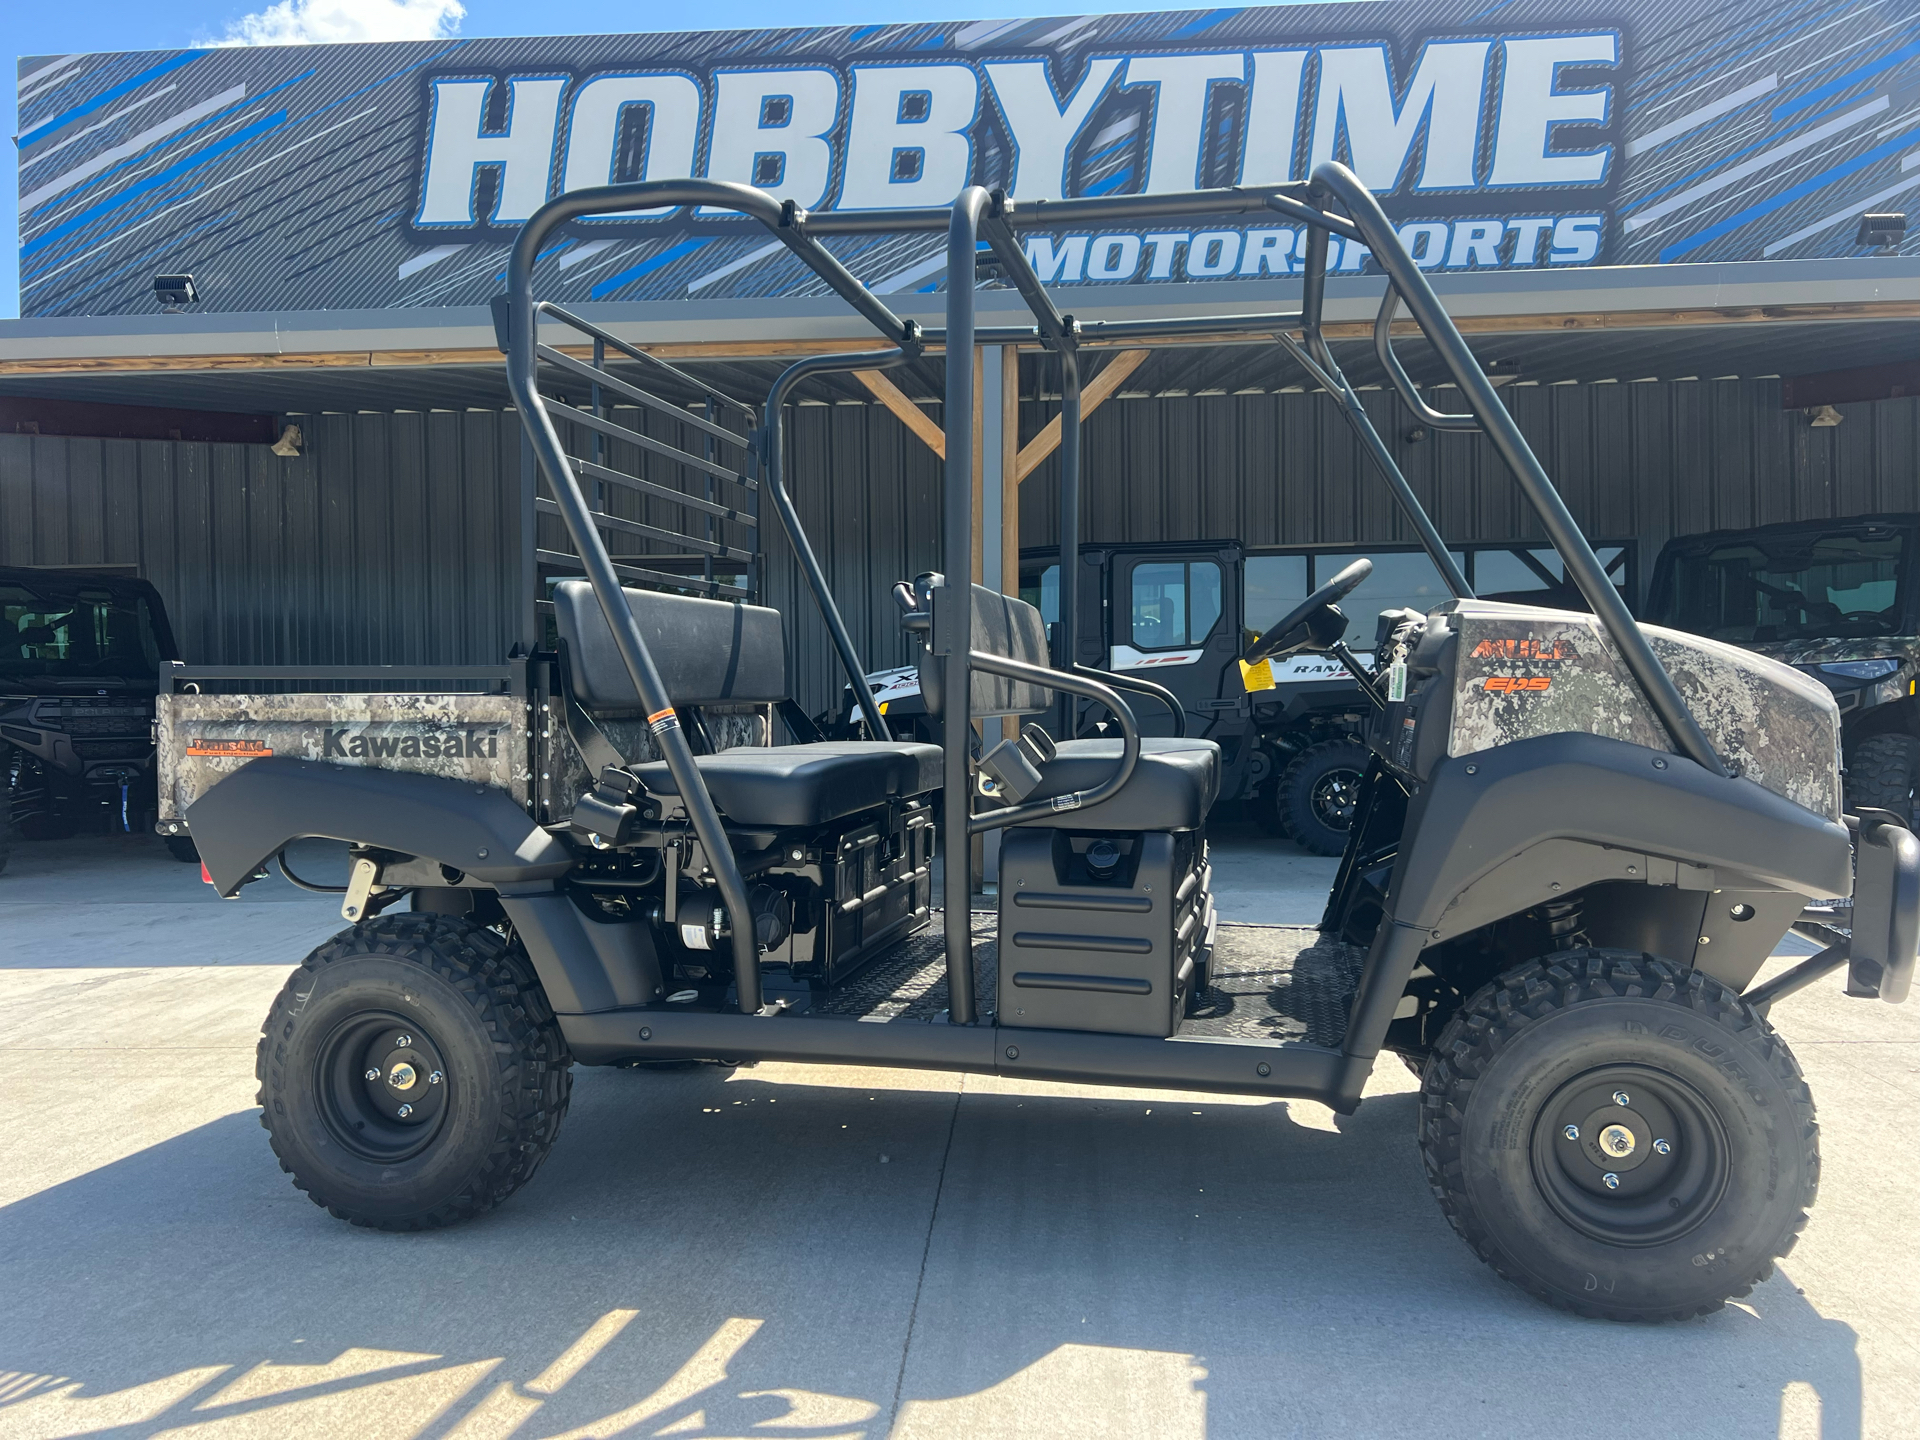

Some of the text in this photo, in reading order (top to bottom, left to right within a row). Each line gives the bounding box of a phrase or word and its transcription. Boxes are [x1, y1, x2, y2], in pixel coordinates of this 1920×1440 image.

[413, 32, 1620, 226] HOBBYTIME
[1293, 663, 1377, 674] RAN
[323, 728, 498, 758] Kawasaki
